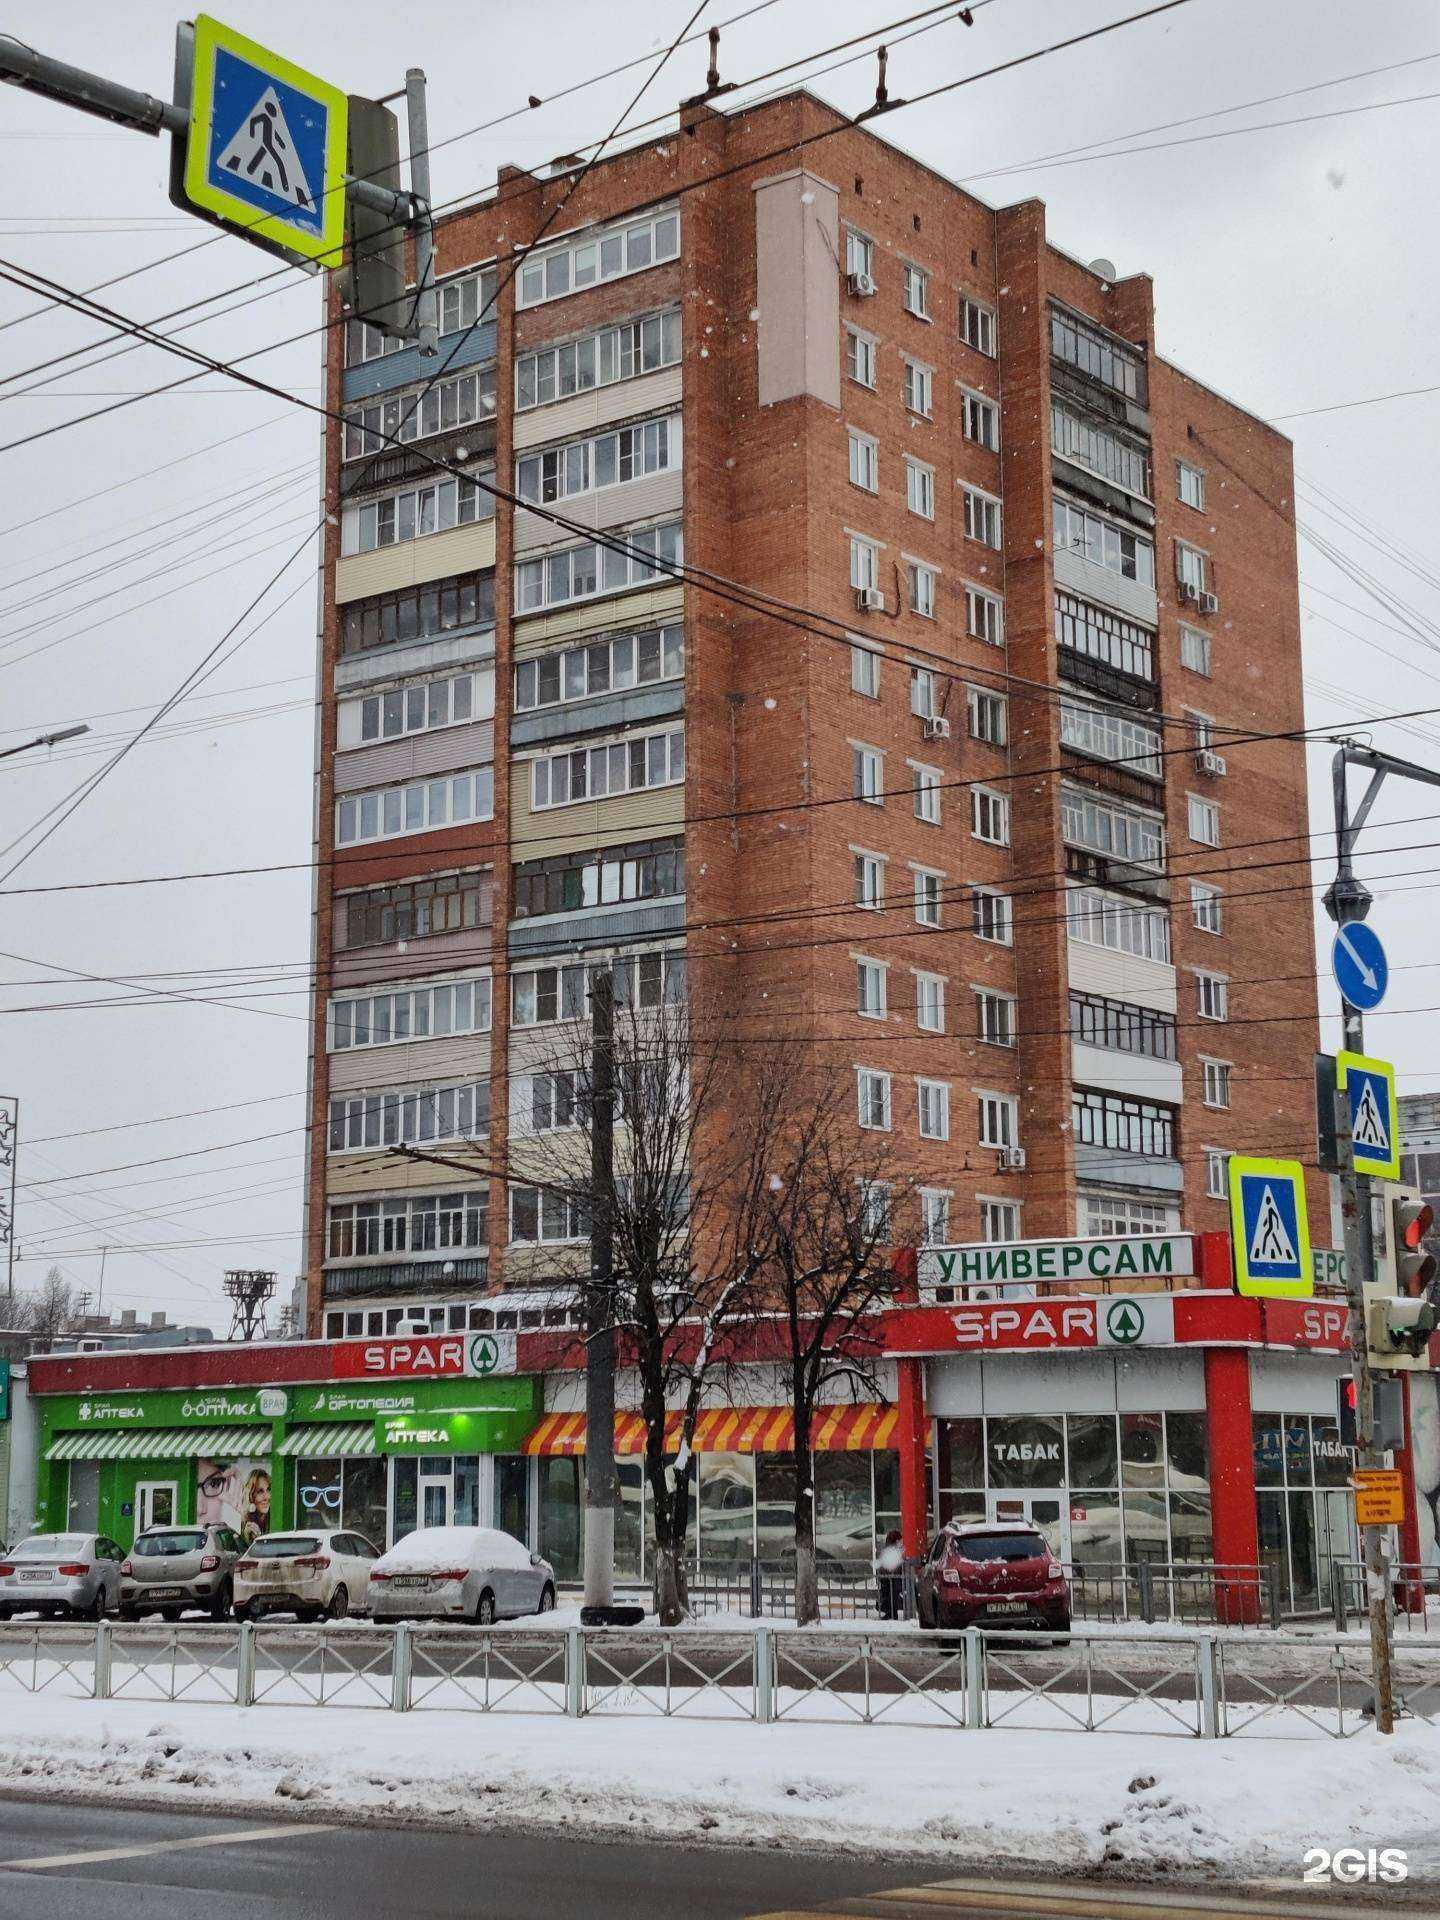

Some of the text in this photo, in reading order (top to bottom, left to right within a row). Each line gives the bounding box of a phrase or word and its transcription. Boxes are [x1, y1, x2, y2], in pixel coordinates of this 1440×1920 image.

[937, 1242, 1172, 1282] УНИВЕРСАМ
[954, 1307, 1094, 1342] SPAR
[364, 1343, 462, 1371] SPAR
[93, 1407, 144, 1419] АПТЕКА
[329, 1397, 414, 1411] ОРТОПЕДИЯ
[385, 1429, 449, 1444] АПТЕКА
[993, 1443, 1060, 1461] ТАБАК
